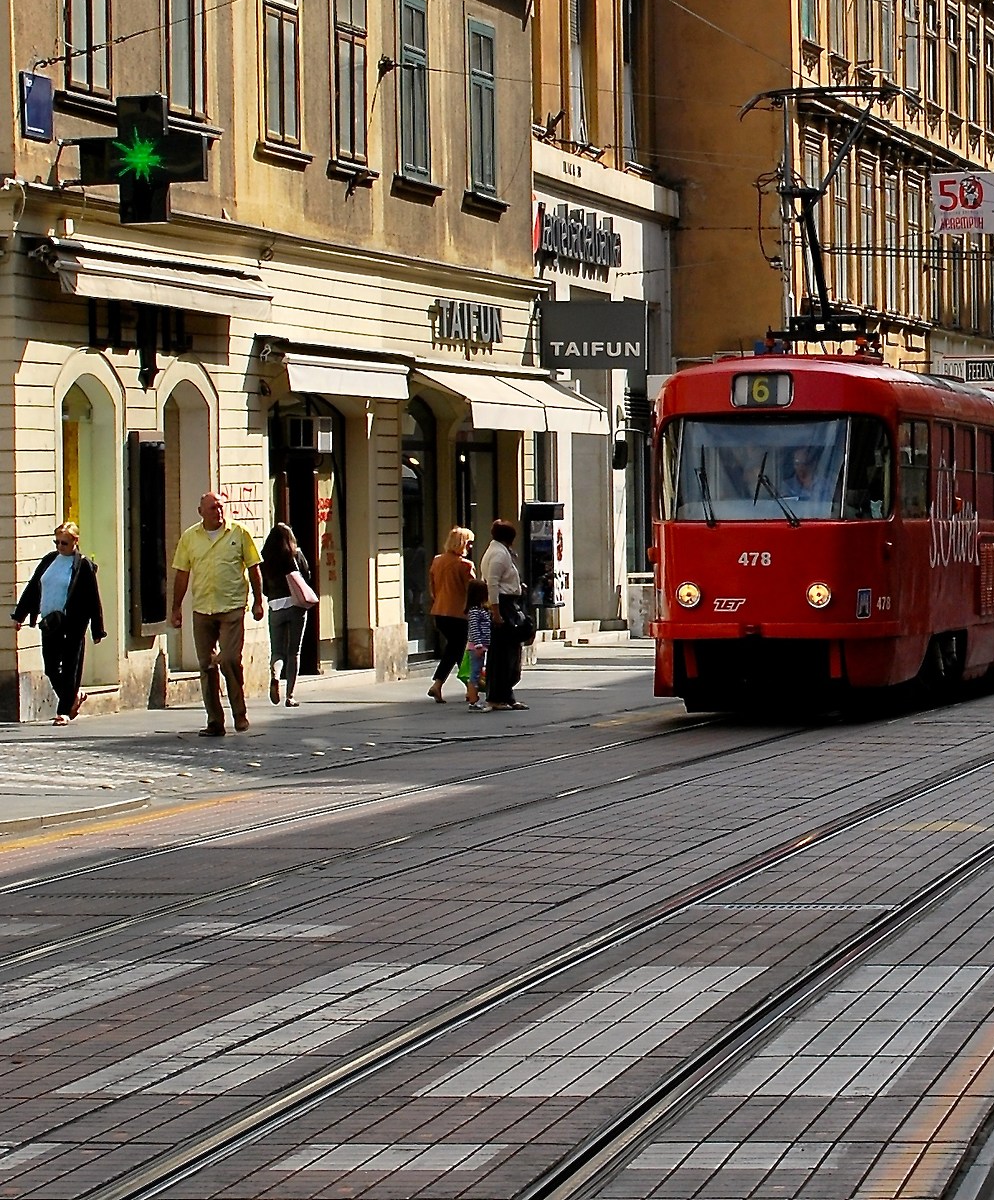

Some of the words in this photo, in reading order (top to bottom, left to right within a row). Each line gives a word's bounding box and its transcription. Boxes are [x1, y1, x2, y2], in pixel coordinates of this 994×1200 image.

[939, 176, 984, 211] 50
[437, 300, 503, 343] TAIFUN
[550, 341, 640, 357] TAIFUN
[752, 377, 770, 403] 6
[738, 552, 771, 566] 478
[876, 596, 891, 611] 478
